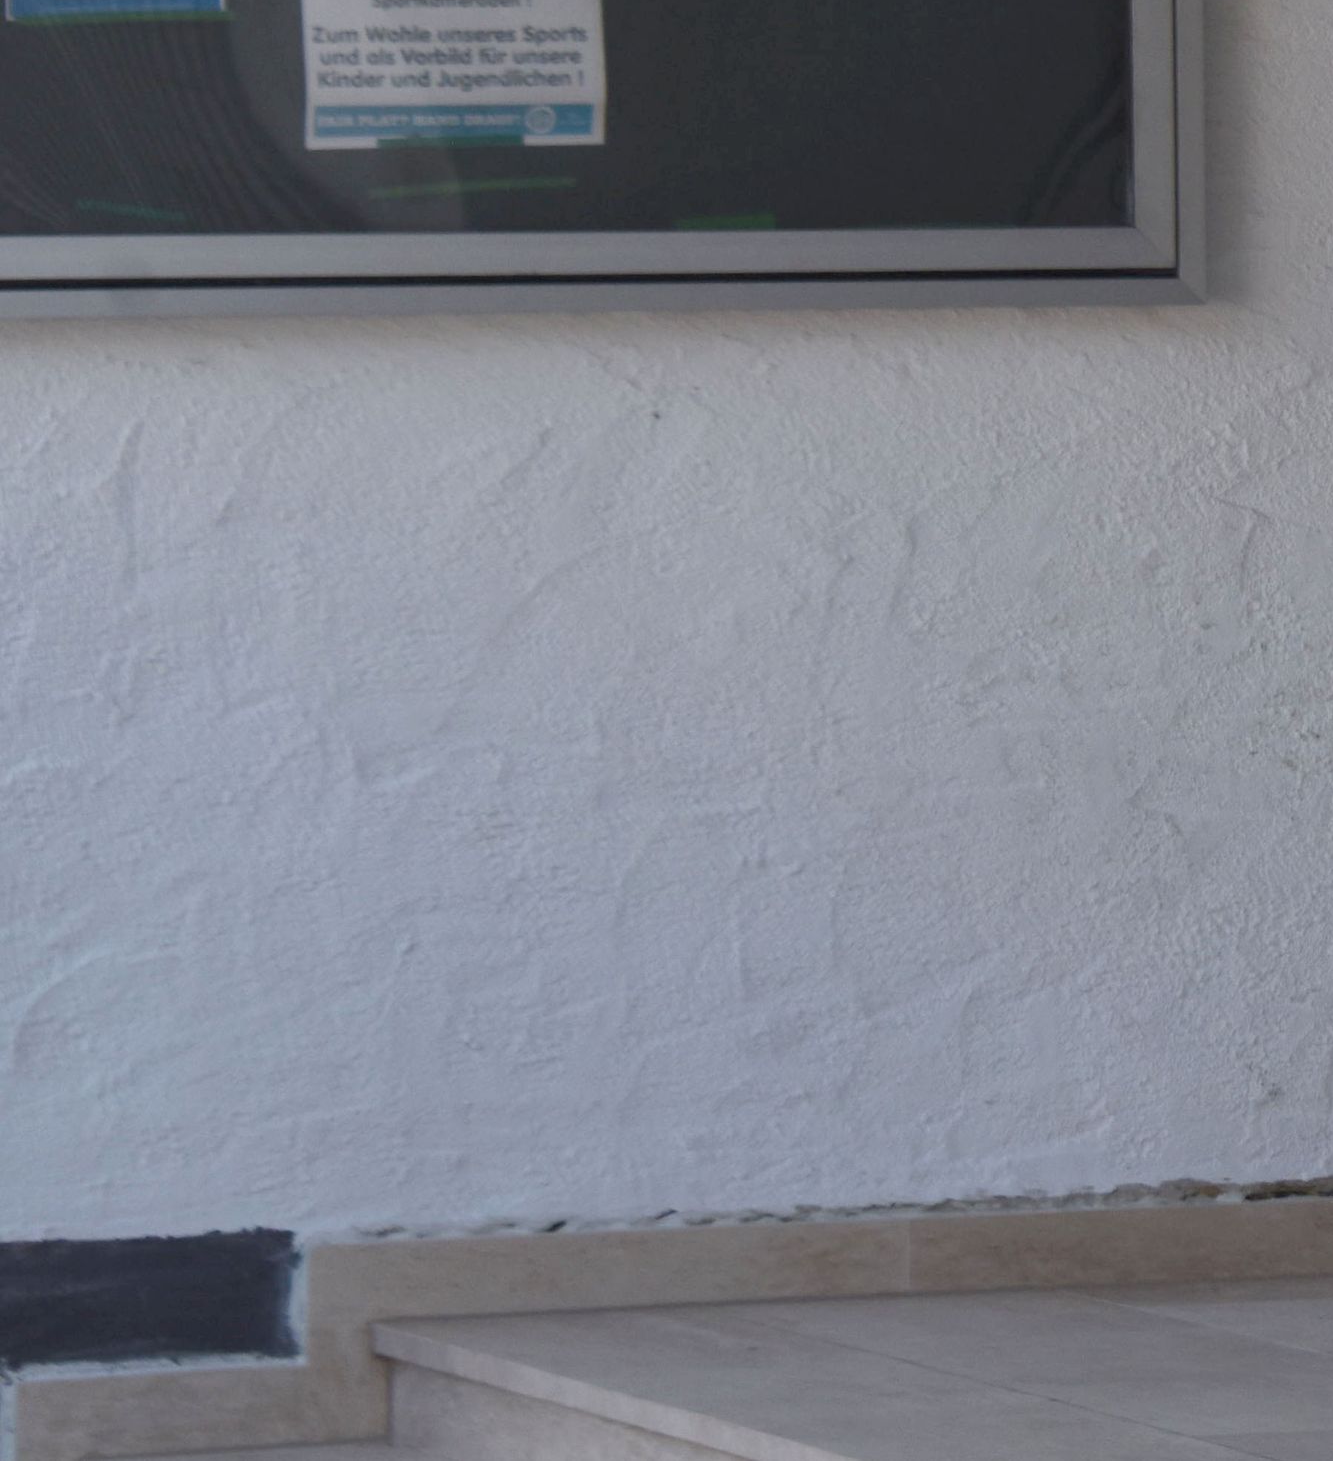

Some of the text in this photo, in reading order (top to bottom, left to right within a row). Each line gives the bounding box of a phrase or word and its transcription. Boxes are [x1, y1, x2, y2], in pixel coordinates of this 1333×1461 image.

[312, 25, 588, 47] Zum Wohle unseres Sports
[320, 48, 582, 66] und als Vorbild für unsere
[317, 70, 384, 87] Kinder
[391, 70, 431, 87] und
[437, 70, 573, 91] Jugendlichen
